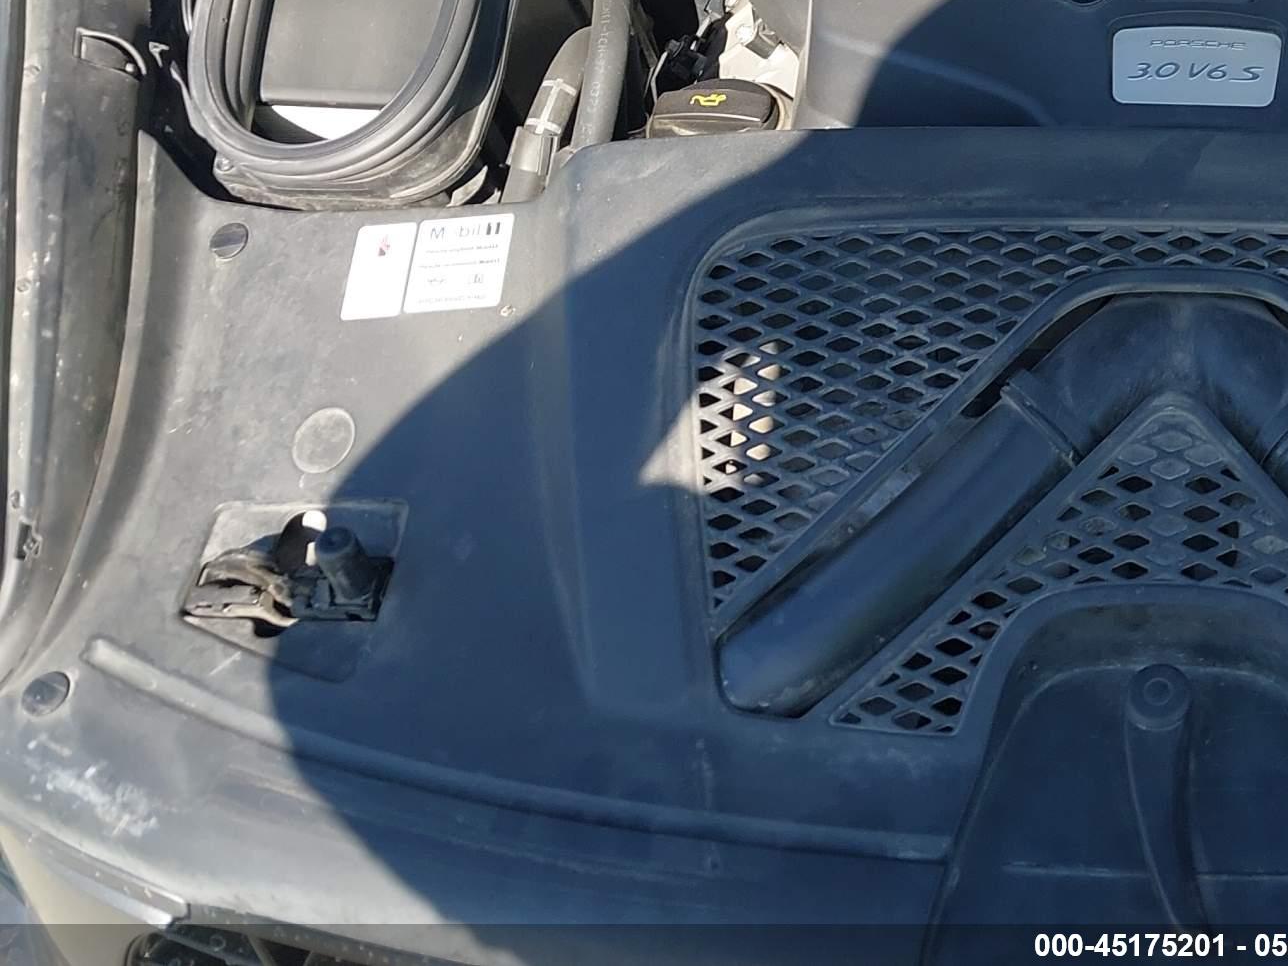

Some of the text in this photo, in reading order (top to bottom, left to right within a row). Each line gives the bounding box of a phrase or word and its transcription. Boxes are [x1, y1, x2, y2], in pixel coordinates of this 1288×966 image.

[1150, 39, 1248, 51] PORSCHE
[1127, 62, 1265, 82] 3.0 V6 S
[430, 223, 482, 240] Mbil
